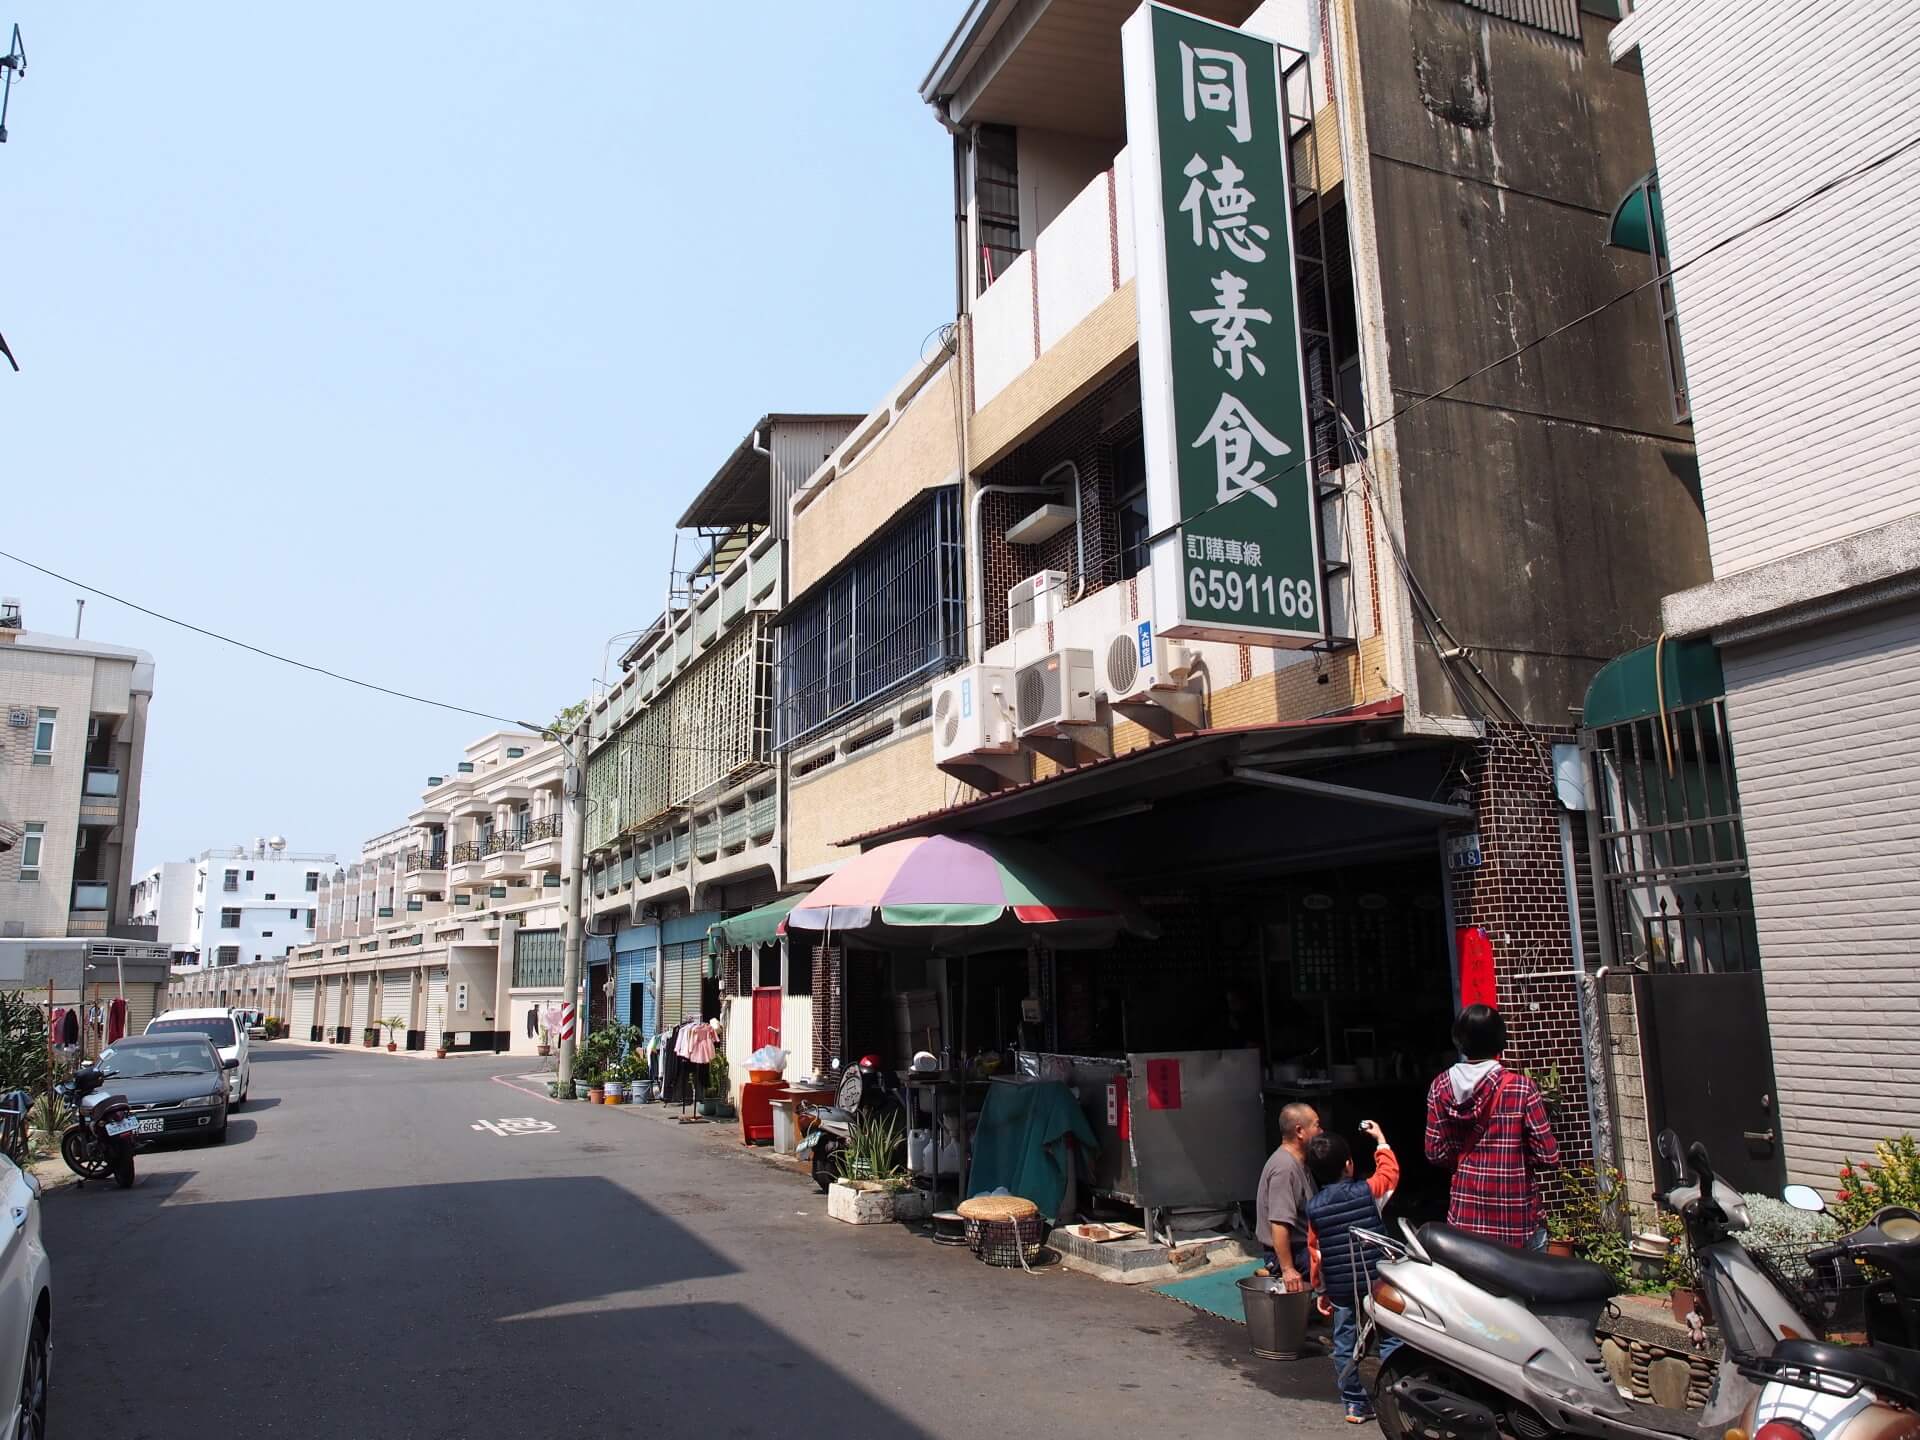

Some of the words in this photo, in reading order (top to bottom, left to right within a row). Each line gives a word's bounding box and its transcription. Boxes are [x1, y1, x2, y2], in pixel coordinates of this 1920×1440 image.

[1178, 40, 1291, 508] 同德素食
[1186, 534, 1263, 567] 訂購專線
[1189, 566, 1314, 619] 6591168
[470, 1117, 560, 1136] 慢
